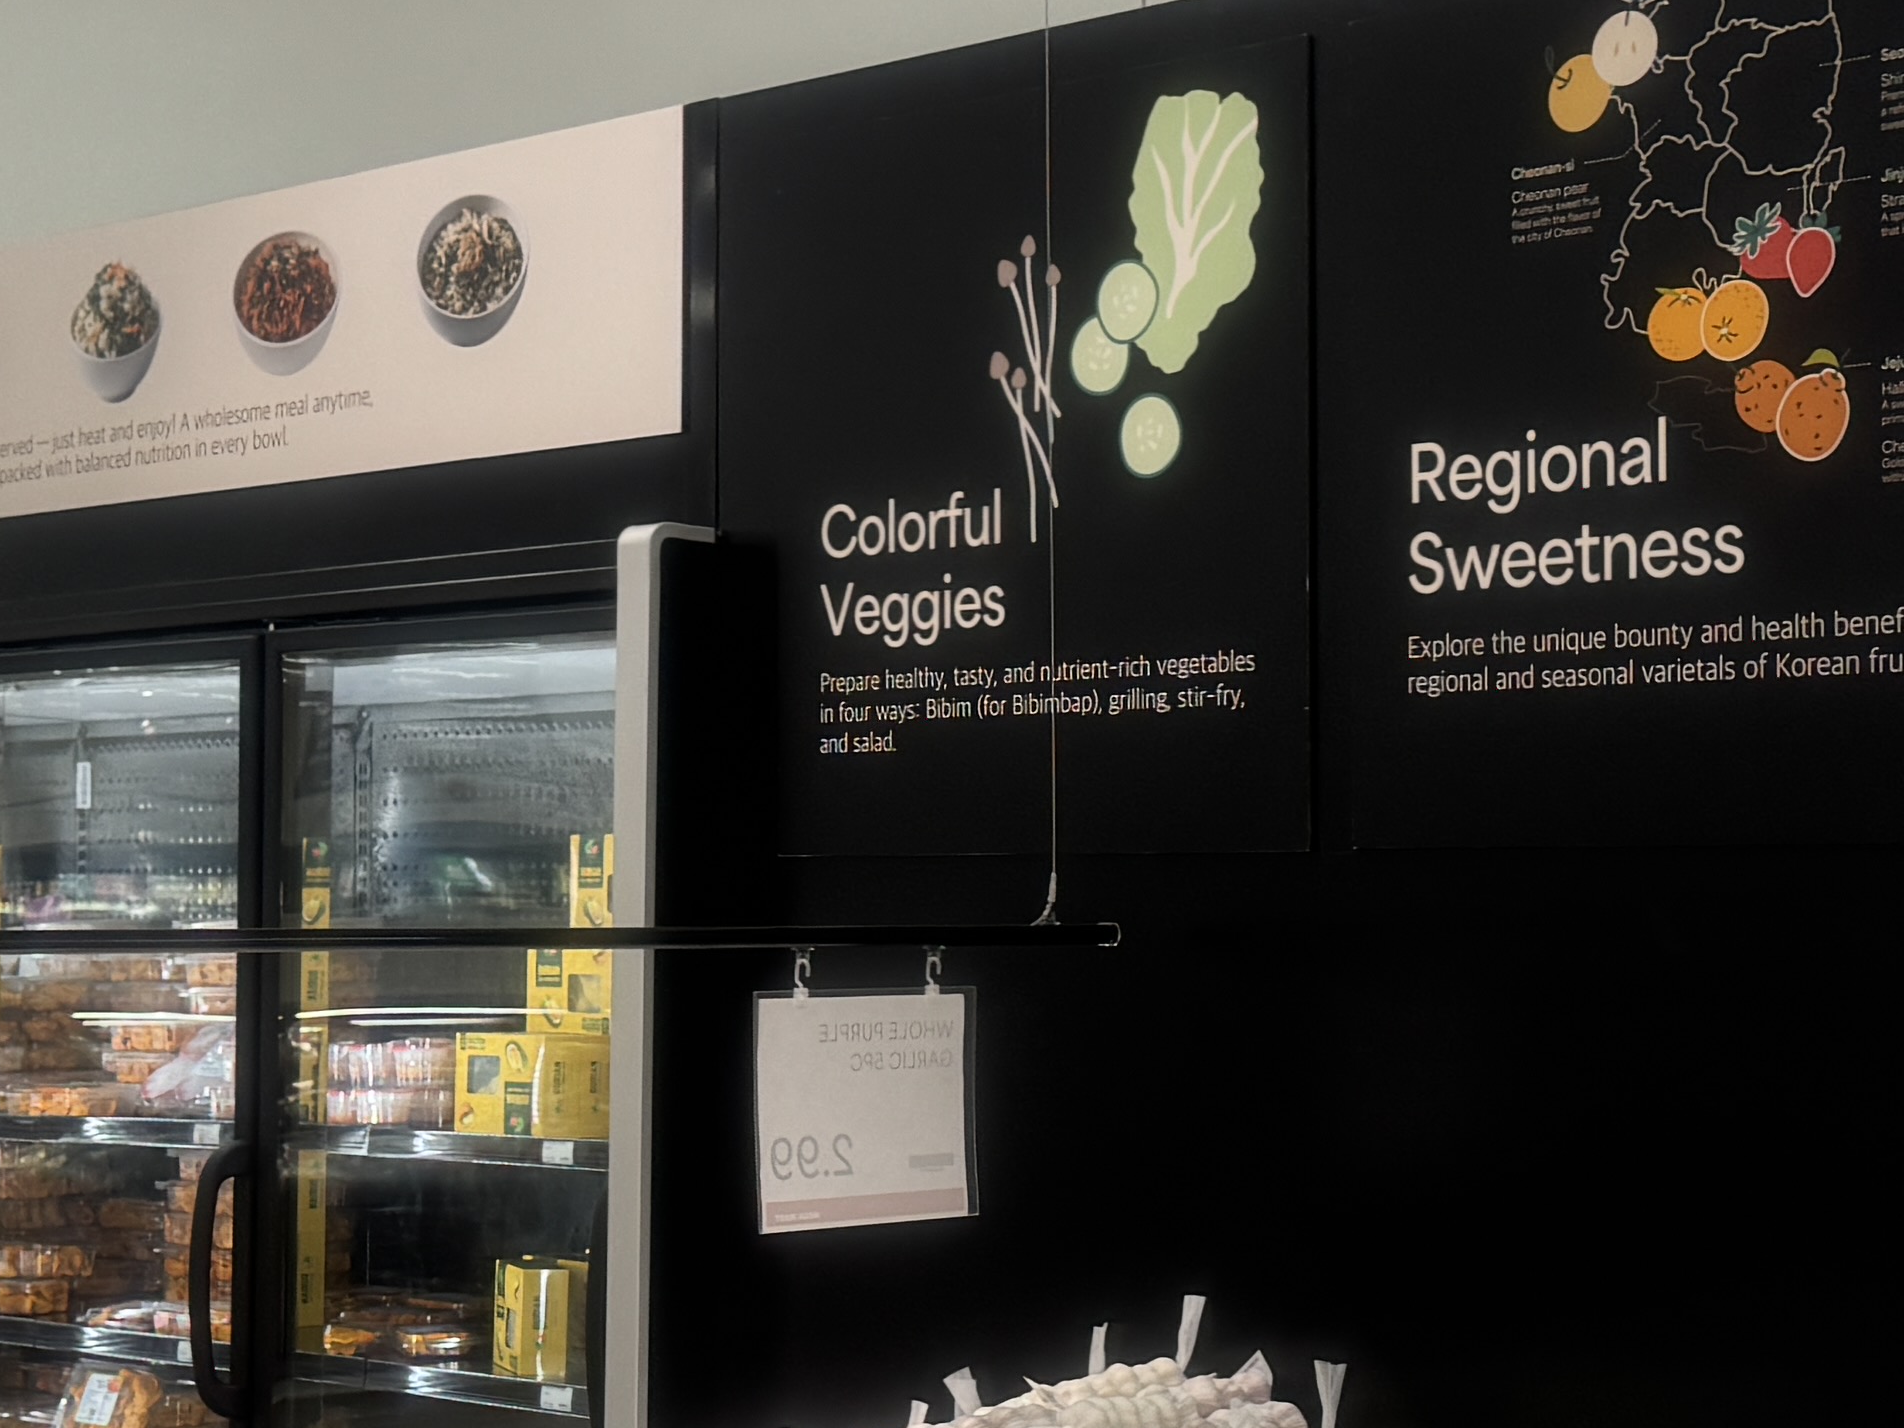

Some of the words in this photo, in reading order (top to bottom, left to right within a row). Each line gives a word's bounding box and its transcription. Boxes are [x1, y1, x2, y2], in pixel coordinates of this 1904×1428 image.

[50, 430, 75, 455] just
[77, 425, 106, 445] heat
[110, 420, 134, 442] and
[179, 412, 191, 432] A
[194, 404, 271, 431] wholesome
[274, 394, 309, 420] meal
[312, 388, 374, 415] anytime,
[0, 461, 42, 487] packed
[45, 455, 72, 478] with
[75, 446, 132, 474] balanced
[135, 442, 191, 467] nutrition
[196, 439, 207, 458] in
[211, 436, 247, 462] every
[252, 424, 289, 450] bowl.
[1409, 415, 1668, 514] Regional
[820, 488, 1002, 559] Colorful
[1408, 523, 1746, 595] Sweetness
[820, 572, 1007, 648] Veggies
[1407, 632, 1485, 663] Explore
[1492, 628, 1526, 656] the
[1533, 623, 1607, 657] unique
[1613, 621, 1693, 654] bounty
[1700, 615, 1744, 643] and
[1751, 610, 1826, 642] health
[820, 670, 880, 697] Prepare
[885, 667, 948, 692] healthy,
[953, 664, 998, 689] tasty,
[1003, 660, 1035, 684] and
[1039, 655, 1151, 683] nutrient-rich
[1156, 648, 1256, 680] vegetables
[820, 703, 834, 725] in
[838, 701, 871, 724] four
[876, 700, 920, 725] ways:
[925, 696, 972, 721] Bibim
[977, 694, 1008, 721] (for
[1012, 687, 1103, 720] Bibimbap),
[1108, 685, 1171, 716] grilling,
[1176, 682, 1246, 712] stir-fry,
[1407, 666, 1489, 699] regional
[1496, 662, 1535, 692] and
[1541, 658, 1635, 689] seasonal
[1641, 653, 1736, 685] varietals
[1743, 650, 1768, 679] of
[1775, 648, 1861, 677] Korean
[820, 731, 848, 755] and
[853, 728, 897, 754] salad.
